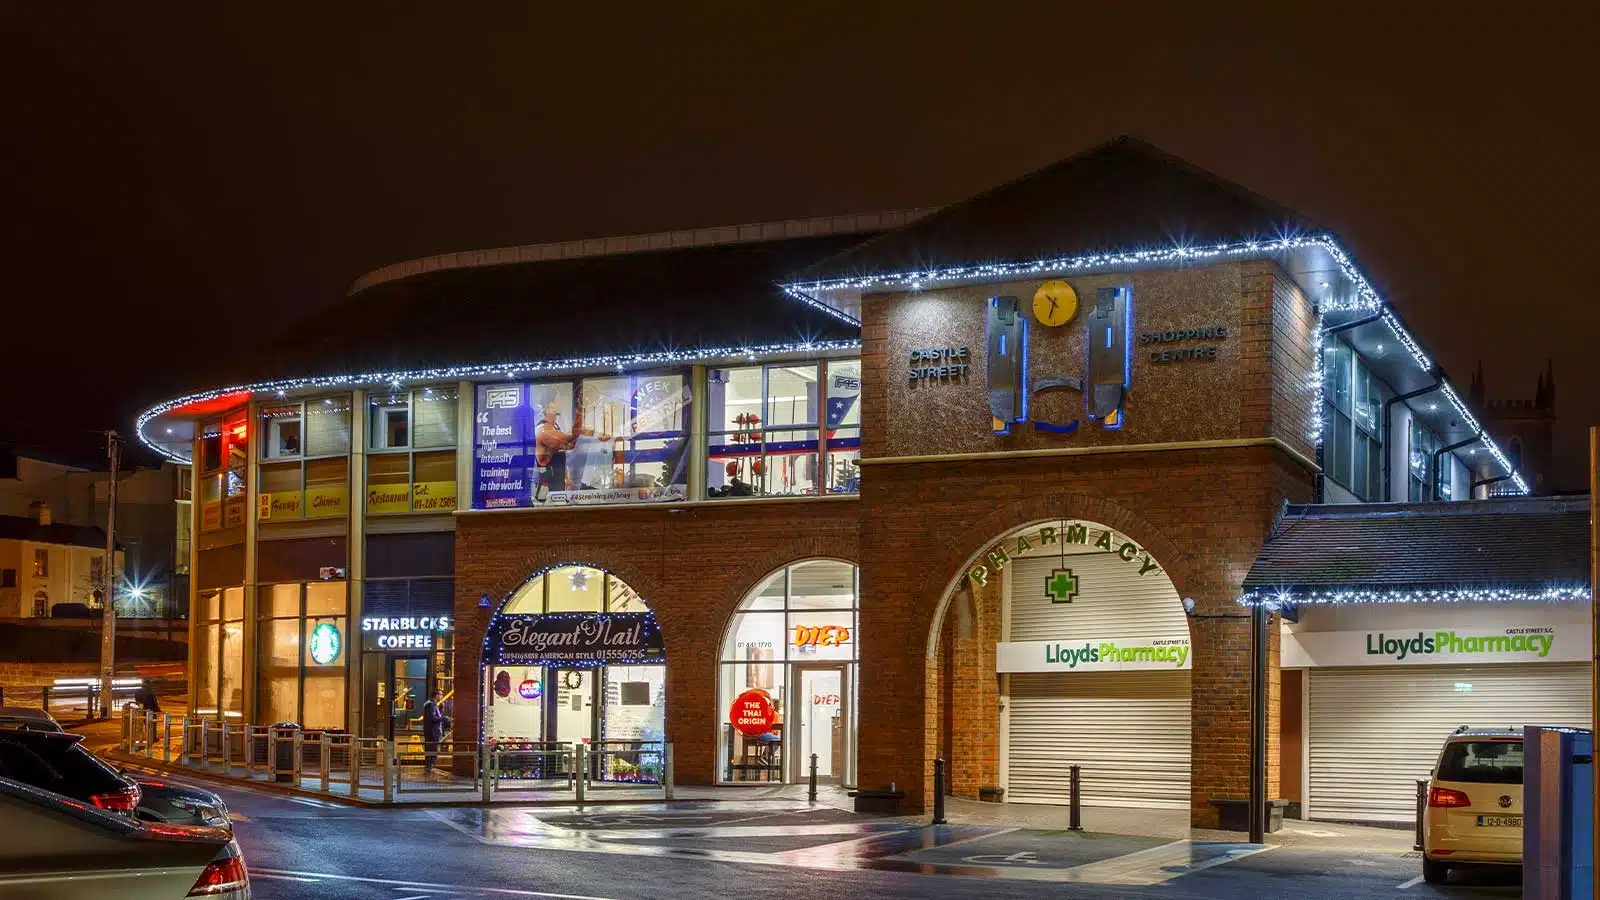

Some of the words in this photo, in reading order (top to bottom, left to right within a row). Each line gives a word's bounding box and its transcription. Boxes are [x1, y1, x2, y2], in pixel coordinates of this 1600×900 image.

[1139, 327, 1228, 343] SHOPPING
[909, 346, 967, 360] CASTLE
[1150, 346, 1216, 363] CENTRE
[908, 364, 968, 379] STREET
[487, 389, 519, 408] F45
[634, 381, 671, 401] WEEK
[482, 426, 495, 436] The
[495, 425, 512, 436] best
[481, 440, 498, 451] high
[481, 453, 513, 464] intensity
[480, 467, 510, 478] training
[480, 481, 487, 491] in
[487, 480, 501, 491] the
[500, 480, 524, 490] world.
[312, 495, 341, 508] Chinese
[368, 490, 408, 505] Restaurant
[968, 525, 1158, 587] PHARMACY
[362, 616, 449, 631] STARBUCKS
[378, 635, 432, 648] COFFEE
[502, 619, 582, 651] Elegant
[580, 618, 641, 646] Nail
[794, 625, 849, 647] DIEP
[1366, 631, 1554, 660] LloydsPharmacy
[540, 652, 574, 660] AMERICAN
[575, 652, 595, 660] STYLE
[1046, 642, 1189, 668] LloydsPharmacy
[813, 694, 840, 706] DIEP
